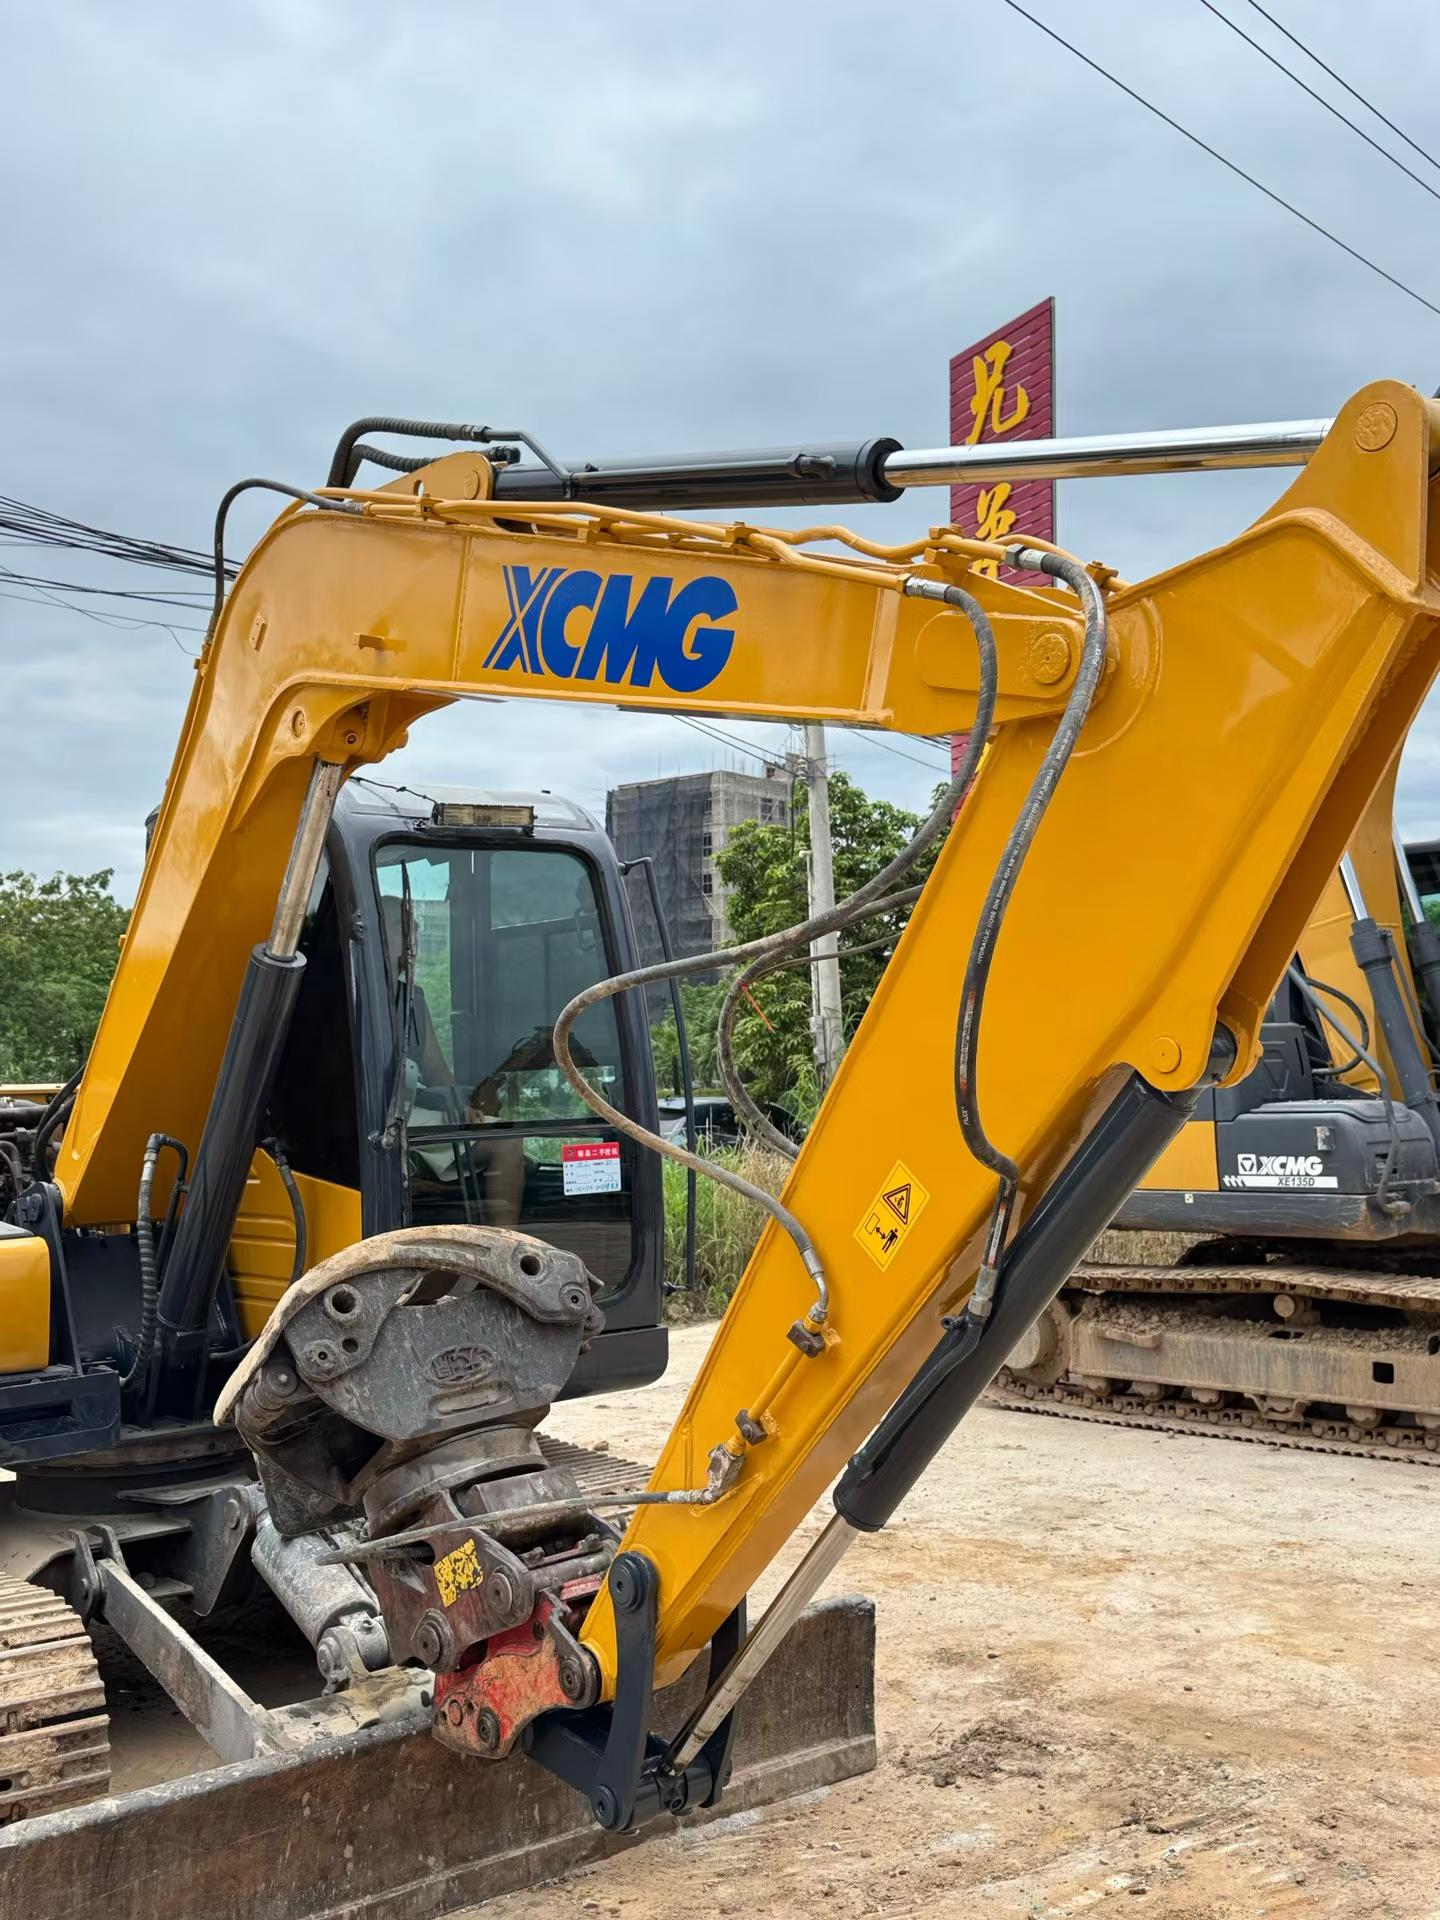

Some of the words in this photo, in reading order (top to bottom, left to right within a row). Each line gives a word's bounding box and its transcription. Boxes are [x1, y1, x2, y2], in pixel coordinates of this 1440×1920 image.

[482, 565, 738, 692] XCMG
[1257, 1155, 1324, 1175] XCMG
[1277, 1177, 1315, 1187] XE135D
